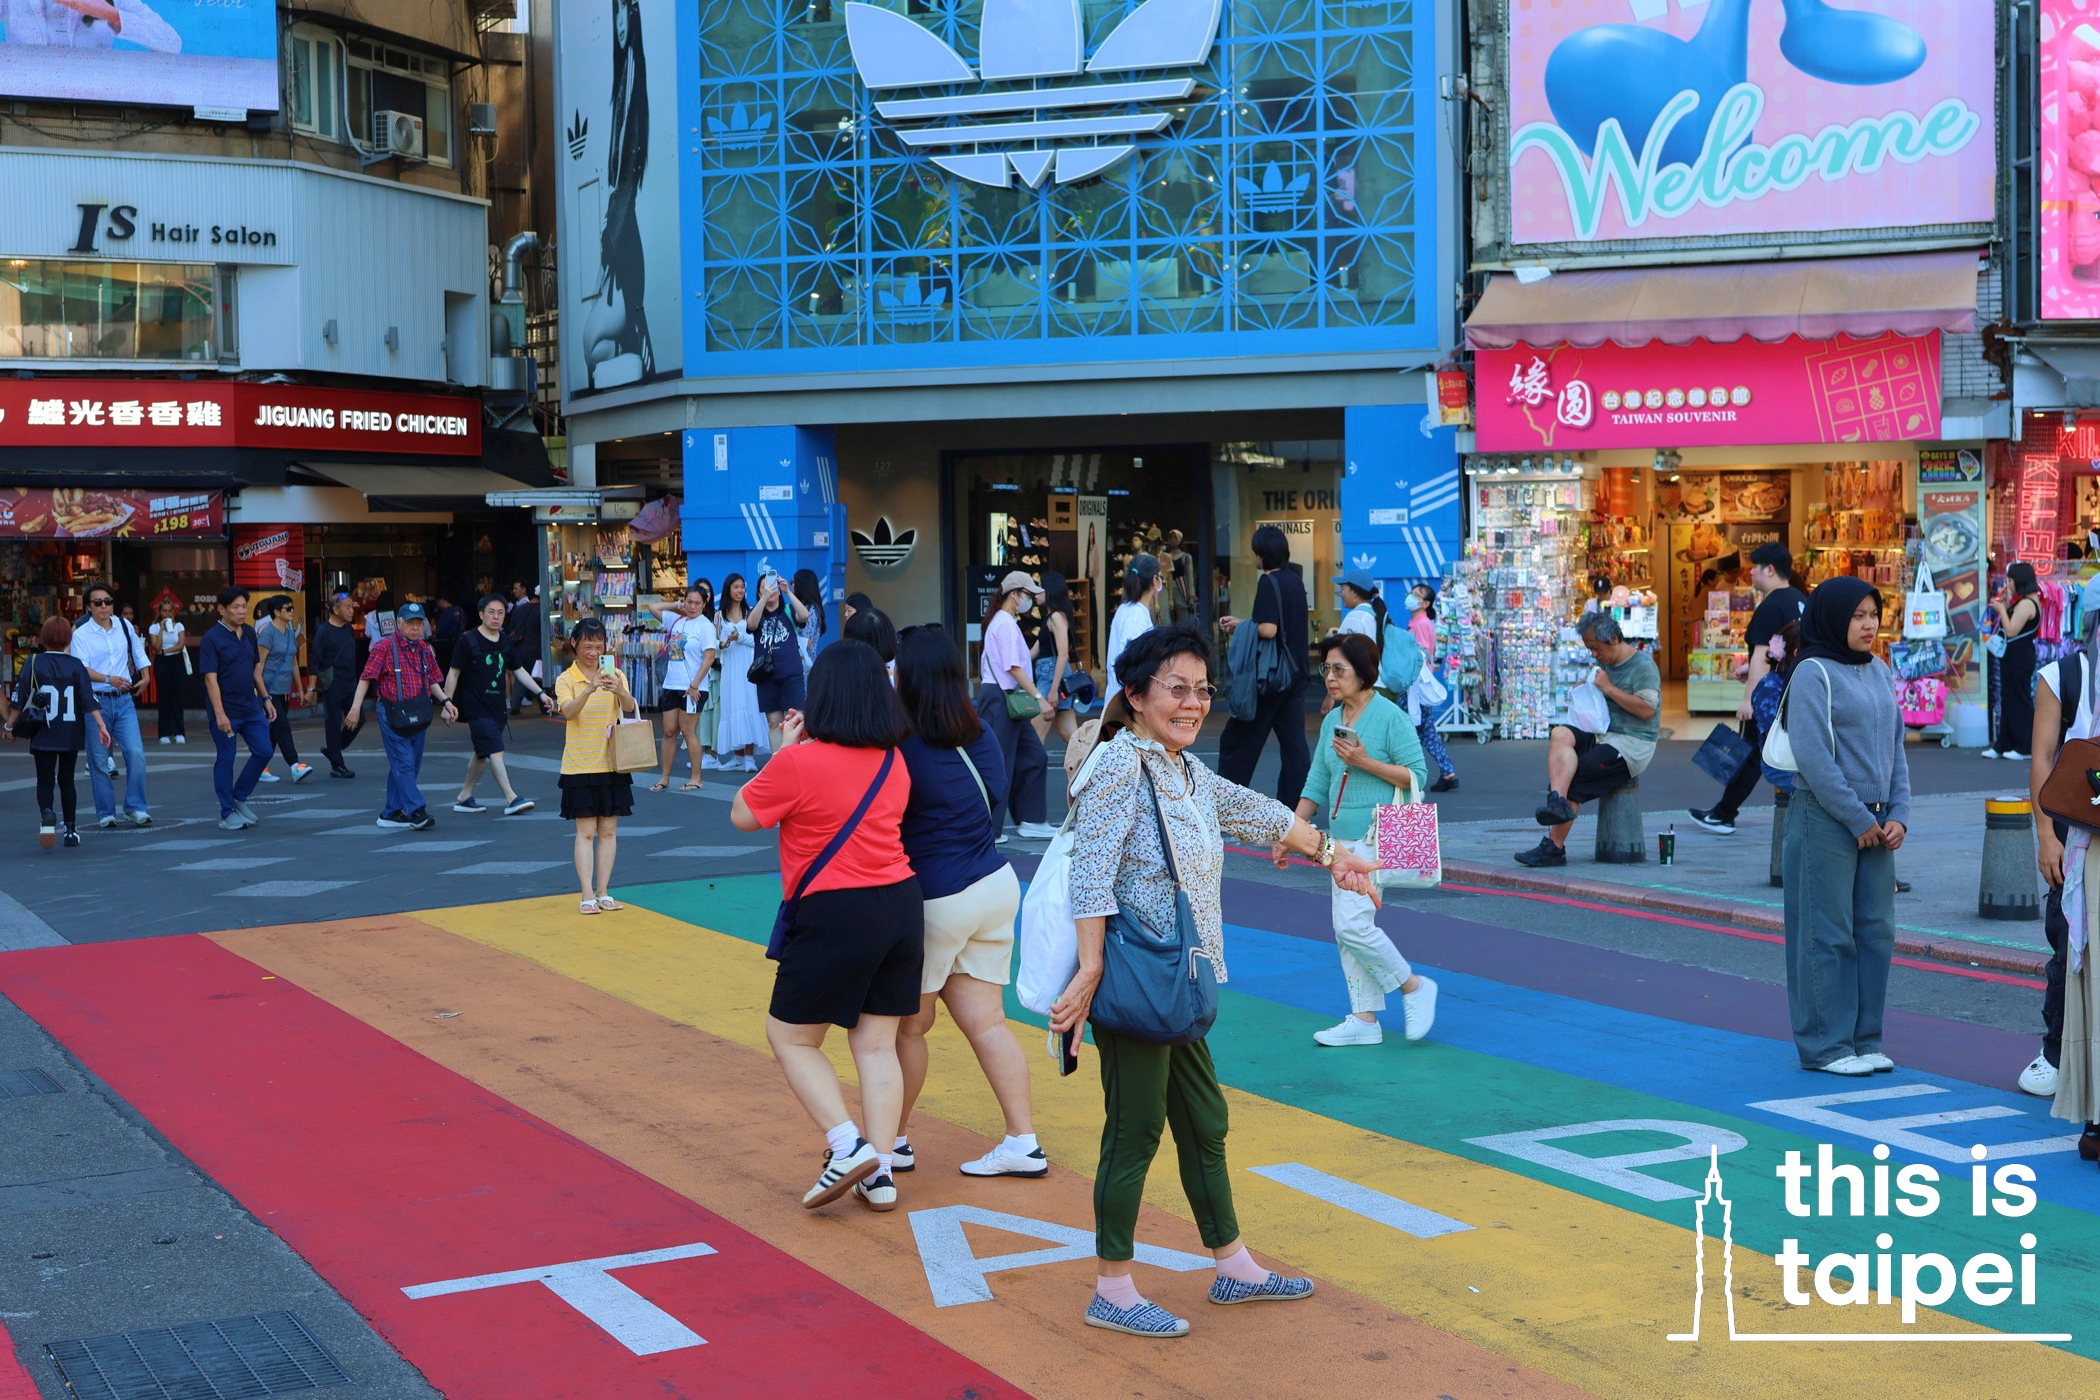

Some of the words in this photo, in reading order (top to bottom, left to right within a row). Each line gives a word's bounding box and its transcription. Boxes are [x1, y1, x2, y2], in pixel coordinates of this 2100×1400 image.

[1511, 84, 1980, 239] Welcome
[152, 223, 200, 242] Hair
[211, 226, 276, 246] Salon
[1602, 385, 1752, 409] 台灣紀念禮品館
[255, 405, 335, 429] JIGUANG
[340, 409, 393, 432] FRIED
[397, 412, 468, 437] CHICKEN
[1611, 413, 1663, 425] TAIWAN
[1666, 411, 1737, 423] SOUVENIR
[1079, 500, 1106, 516] ORIGINALS
[1263, 490, 1297, 511] THE
[1304, 489, 1341, 510] ORI
[154, 514, 188, 534] $198
